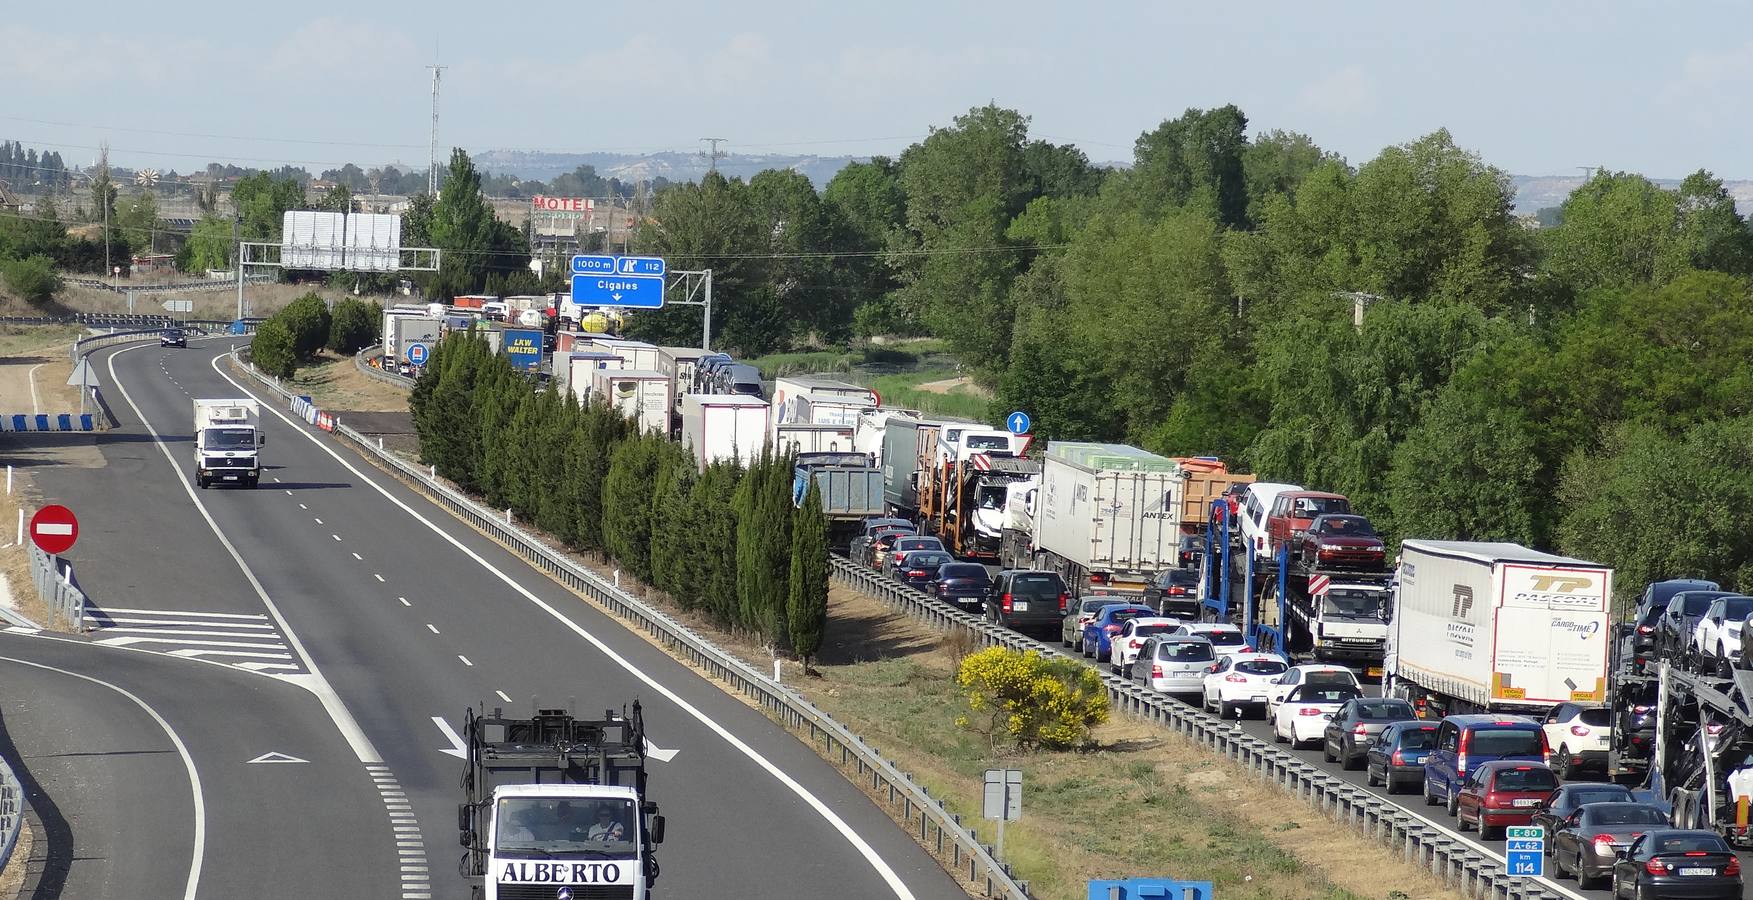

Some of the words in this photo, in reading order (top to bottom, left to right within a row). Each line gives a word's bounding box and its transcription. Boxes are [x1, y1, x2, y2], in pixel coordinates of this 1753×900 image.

[532, 196, 593, 211] MOTEL
[577, 260, 600, 268] 1000
[645, 263, 660, 271] 112
[597, 280, 638, 291] Cigales
[513, 338, 532, 347] LKW
[507, 345, 538, 355] WALTER
[1142, 512, 1173, 520] ANTEX
[1551, 620, 1574, 628] CARGO
[1572, 624, 1591, 633] TIME
[1513, 829, 1538, 837] E-80
[1513, 841, 1538, 850] A-62
[1519, 853, 1531, 861] km
[501, 862, 620, 883] ALBERTO
[1515, 862, 1535, 874] 114
